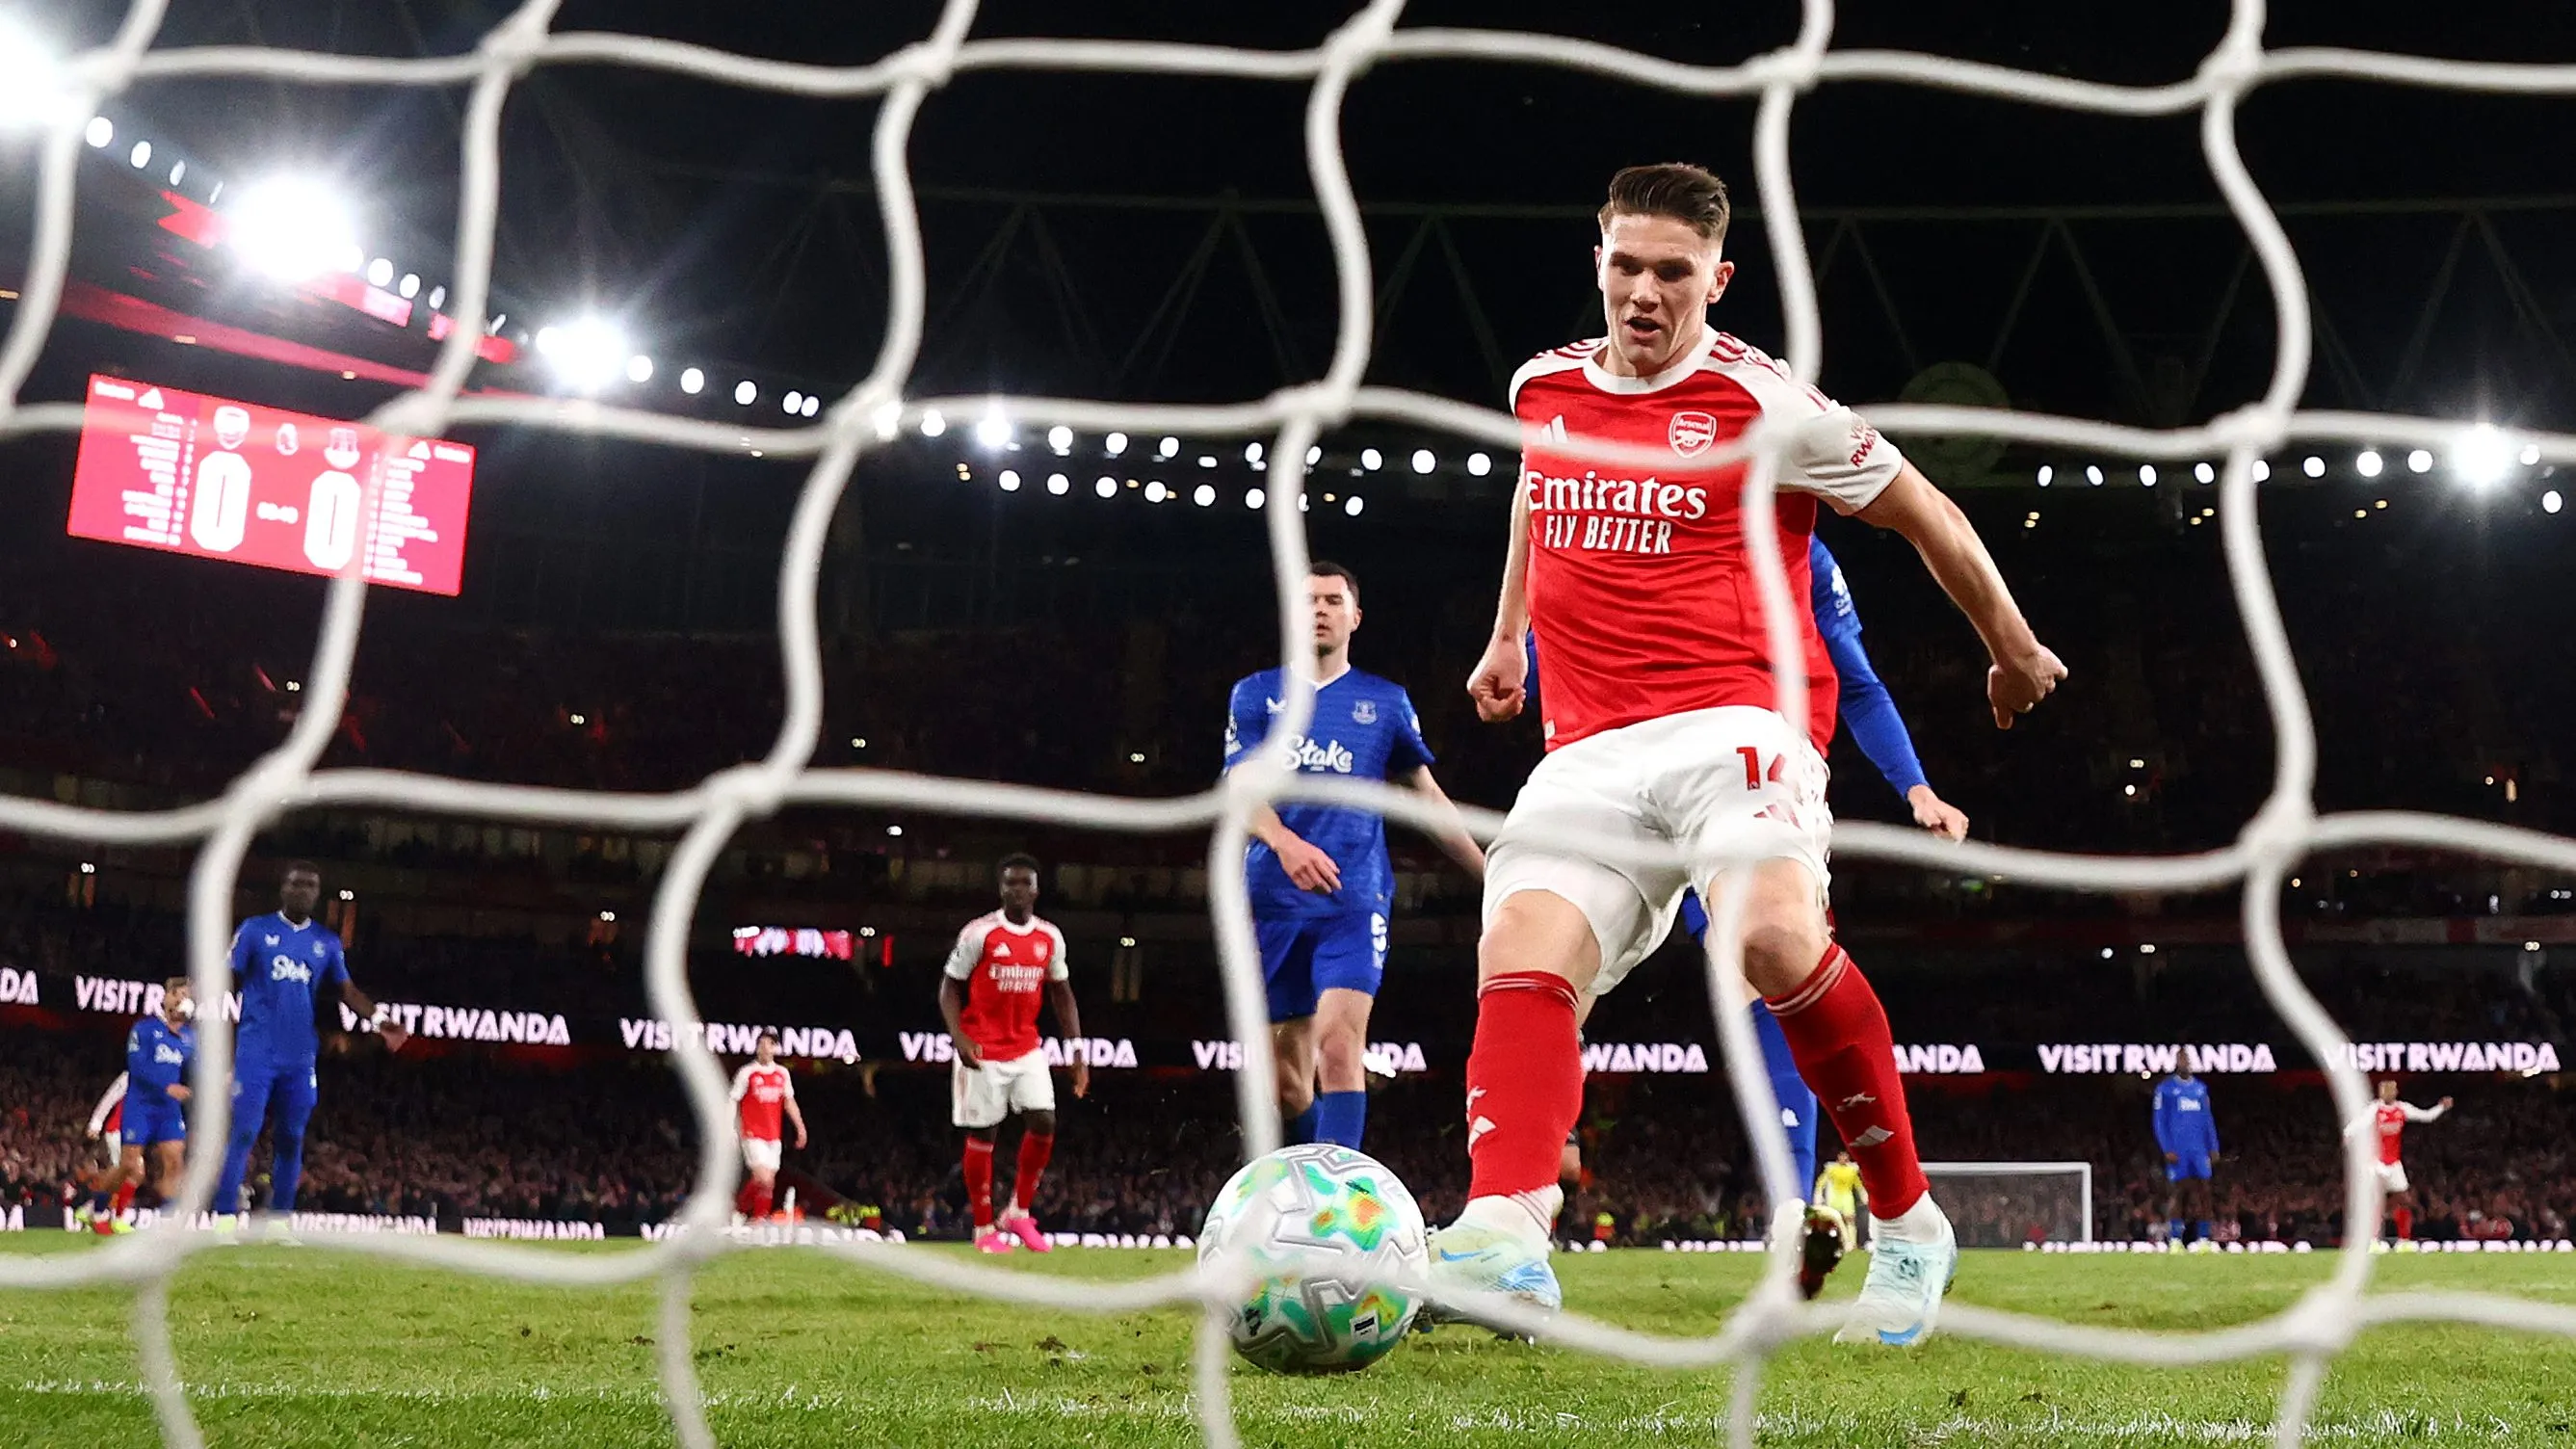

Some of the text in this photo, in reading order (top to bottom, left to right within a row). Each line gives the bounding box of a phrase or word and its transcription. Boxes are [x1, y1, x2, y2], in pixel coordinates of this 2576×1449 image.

[191, 451, 251, 552] 0
[304, 470, 361, 570] 0
[1526, 470, 1707, 520] Emirates
[1543, 514, 1672, 555] FLY BETTER
[1278, 734, 1354, 774] Stake
